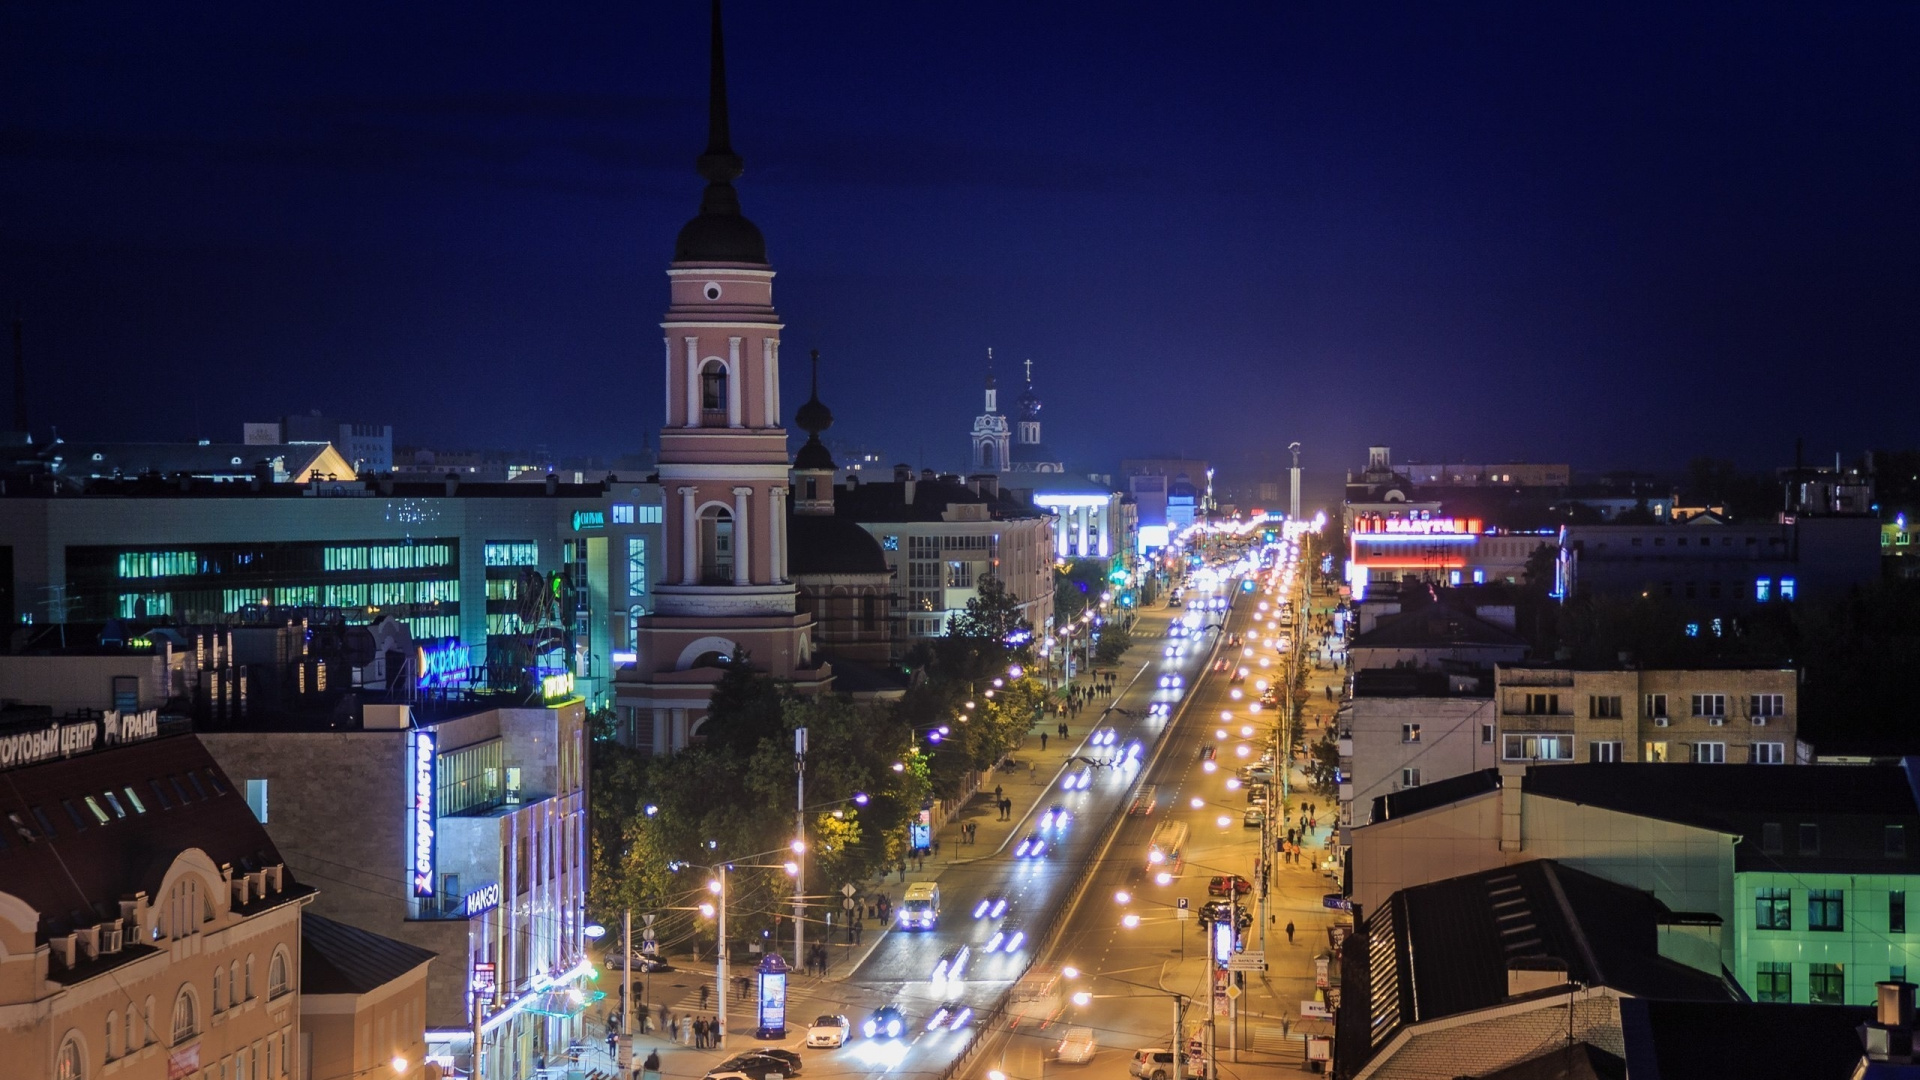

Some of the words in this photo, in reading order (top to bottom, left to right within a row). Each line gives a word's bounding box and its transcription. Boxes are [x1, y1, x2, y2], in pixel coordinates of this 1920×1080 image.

[61, 722, 97, 757] ЦЕНТР
[122, 709, 158, 742] ГРАНД
[467, 883, 499, 915] MANGO
